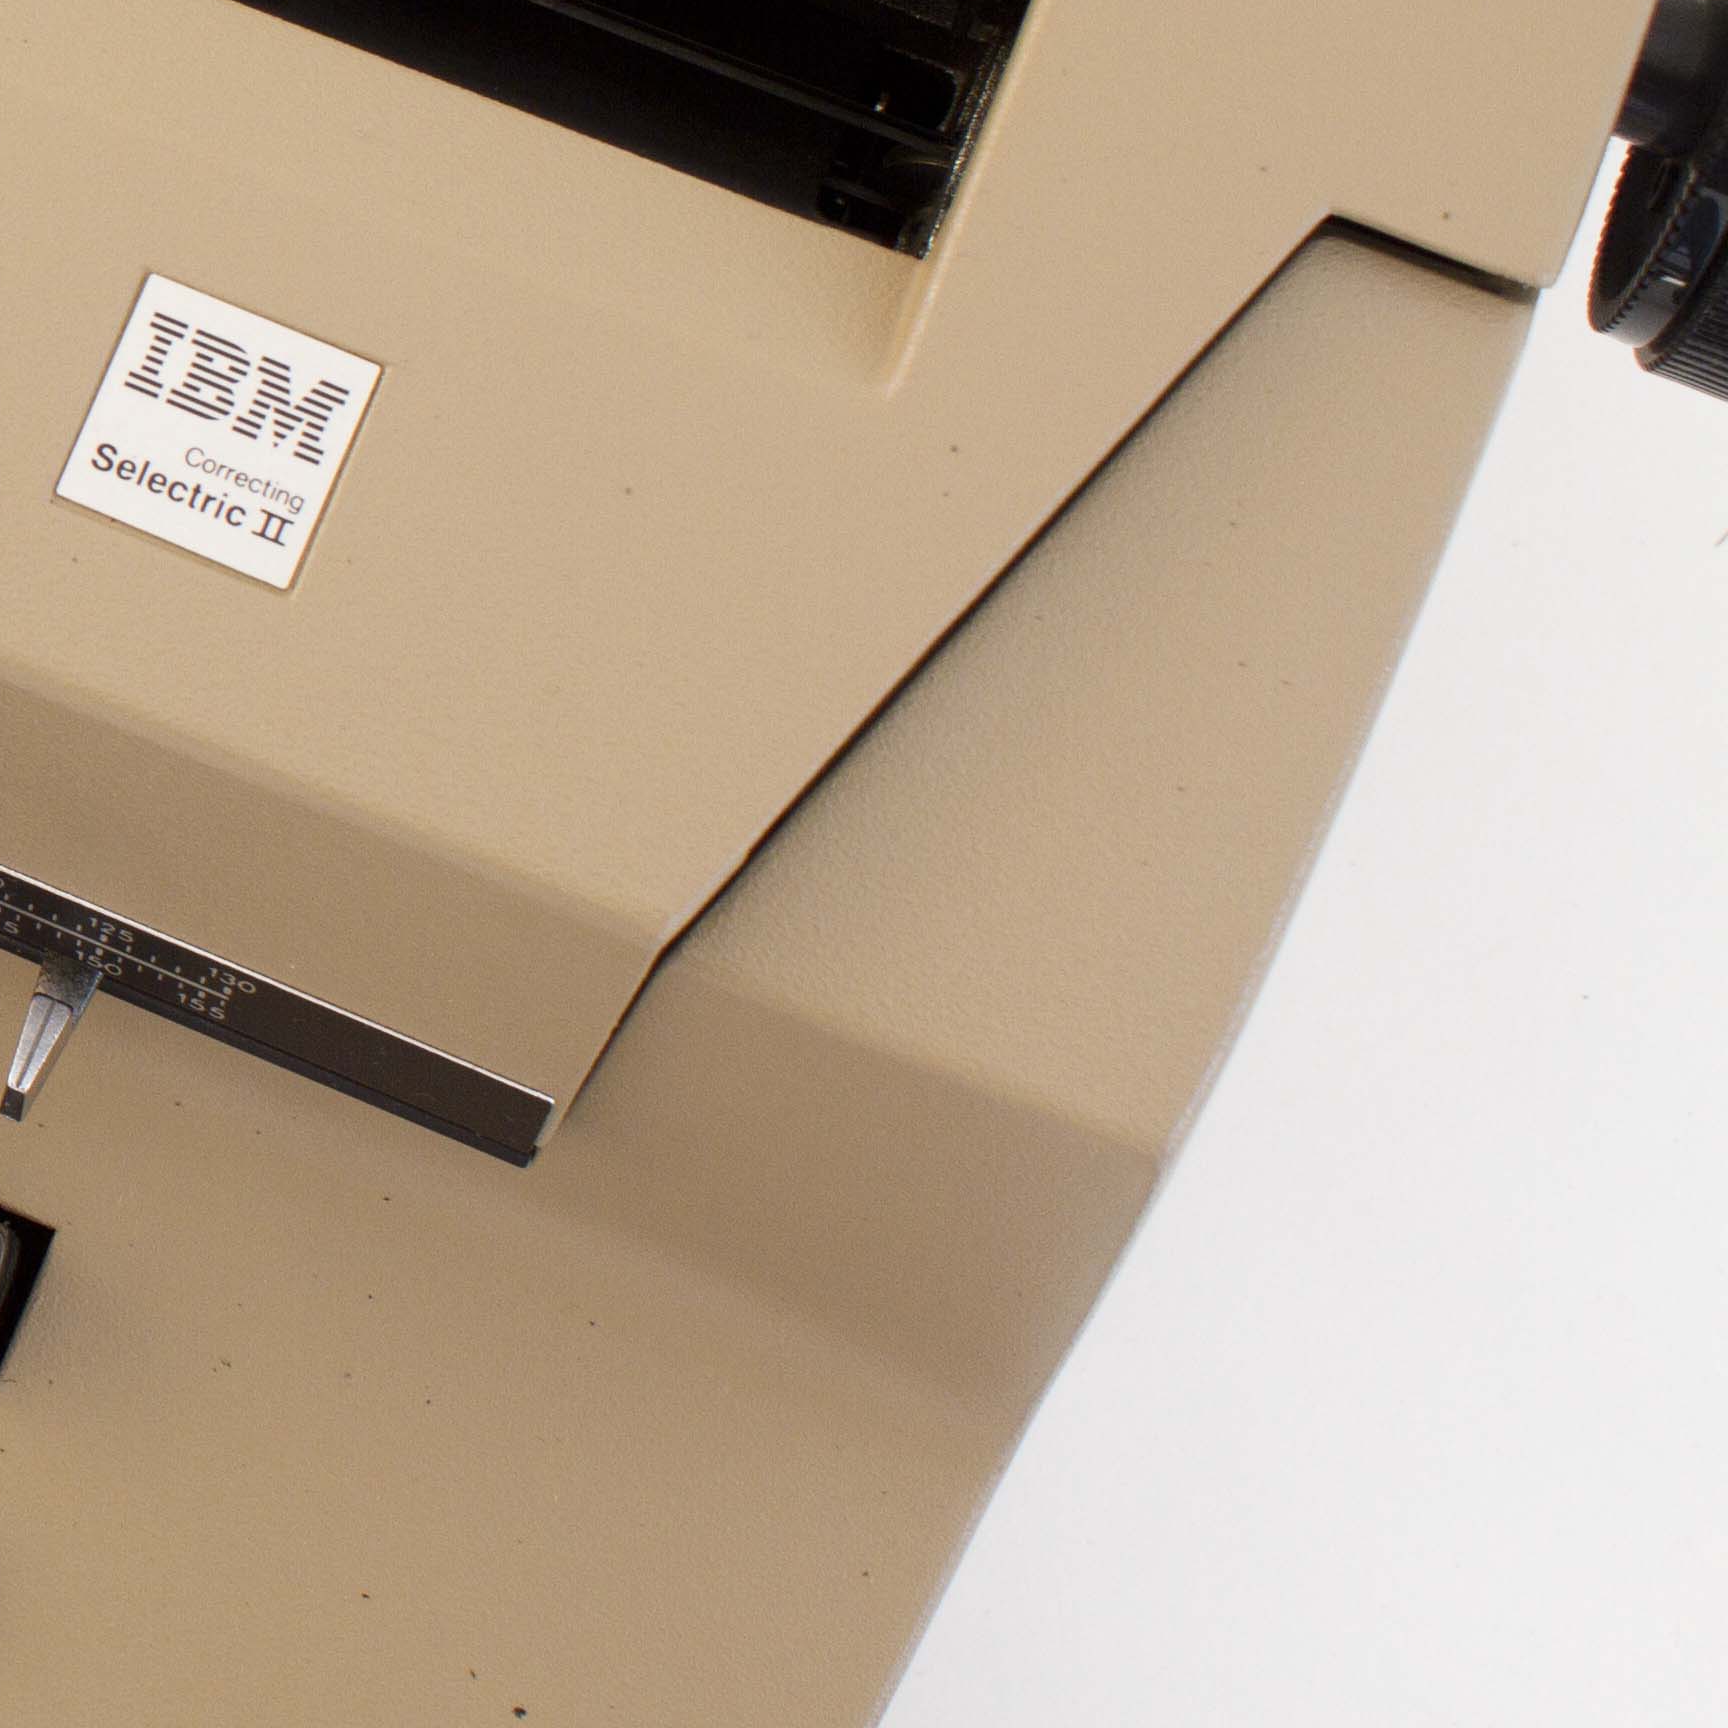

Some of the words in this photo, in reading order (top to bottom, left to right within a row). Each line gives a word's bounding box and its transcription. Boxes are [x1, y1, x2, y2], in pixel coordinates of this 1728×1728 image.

[124, 312, 350, 465] IBM
[90, 443, 247, 526] Selectric
[184, 447, 305, 515] Correcting
[76, 949, 122, 976] 150
[177, 992, 225, 1020] 155
[88, 916, 134, 943] 125
[210, 967, 256, 994] 130
